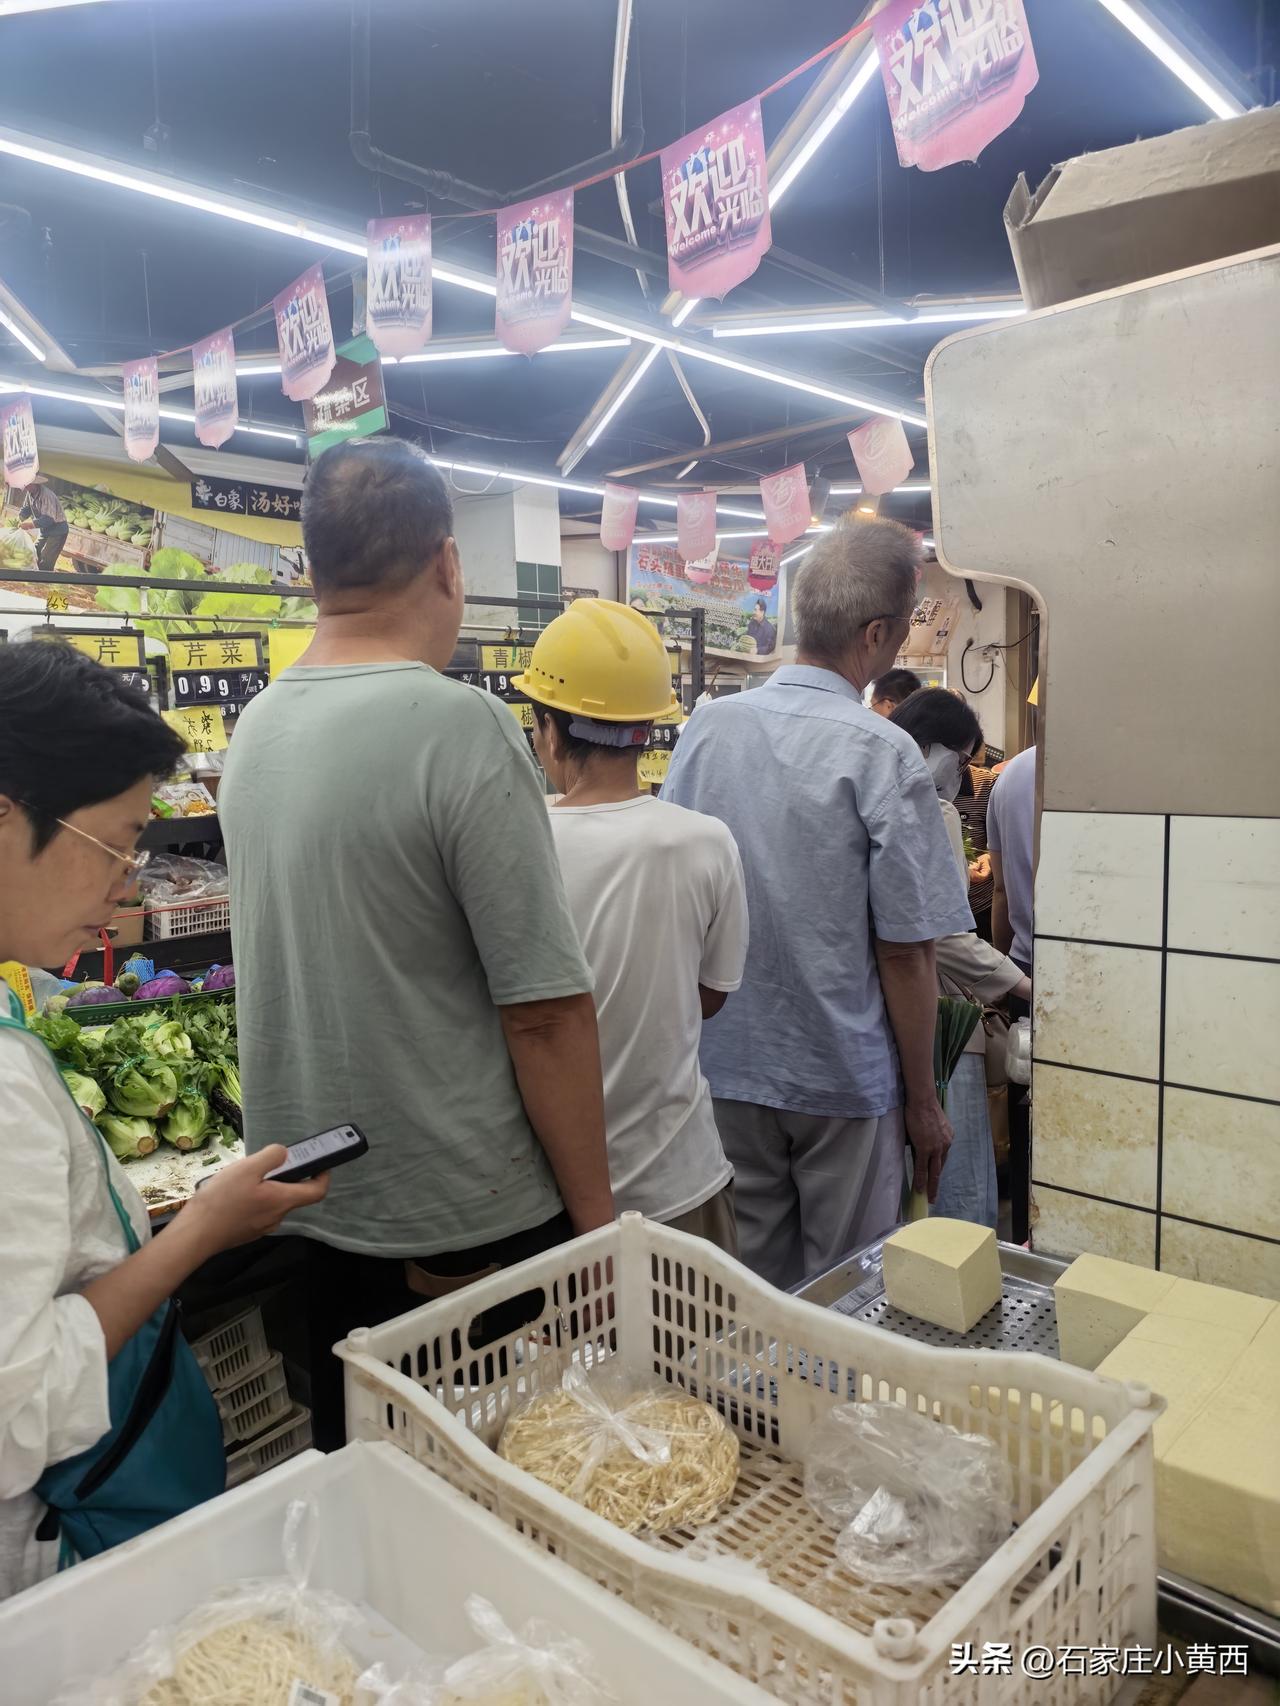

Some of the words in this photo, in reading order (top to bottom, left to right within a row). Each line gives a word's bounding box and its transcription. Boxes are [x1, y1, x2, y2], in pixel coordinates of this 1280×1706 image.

[670, 137, 748, 244] 欢迎
[718, 165, 765, 231] 光临
[669, 225, 717, 256] Welcome
[501, 221, 561, 295] 欢迎
[535, 248, 569, 297] 光临
[281, 290, 324, 359] 欢迎
[214, 488, 244, 511] 白象
[183, 641, 243, 667] 芹菜
[492, 648, 534, 669] 青椒
[177, 675, 229, 697] 0.99
[483, 674, 520, 694] 1.9
